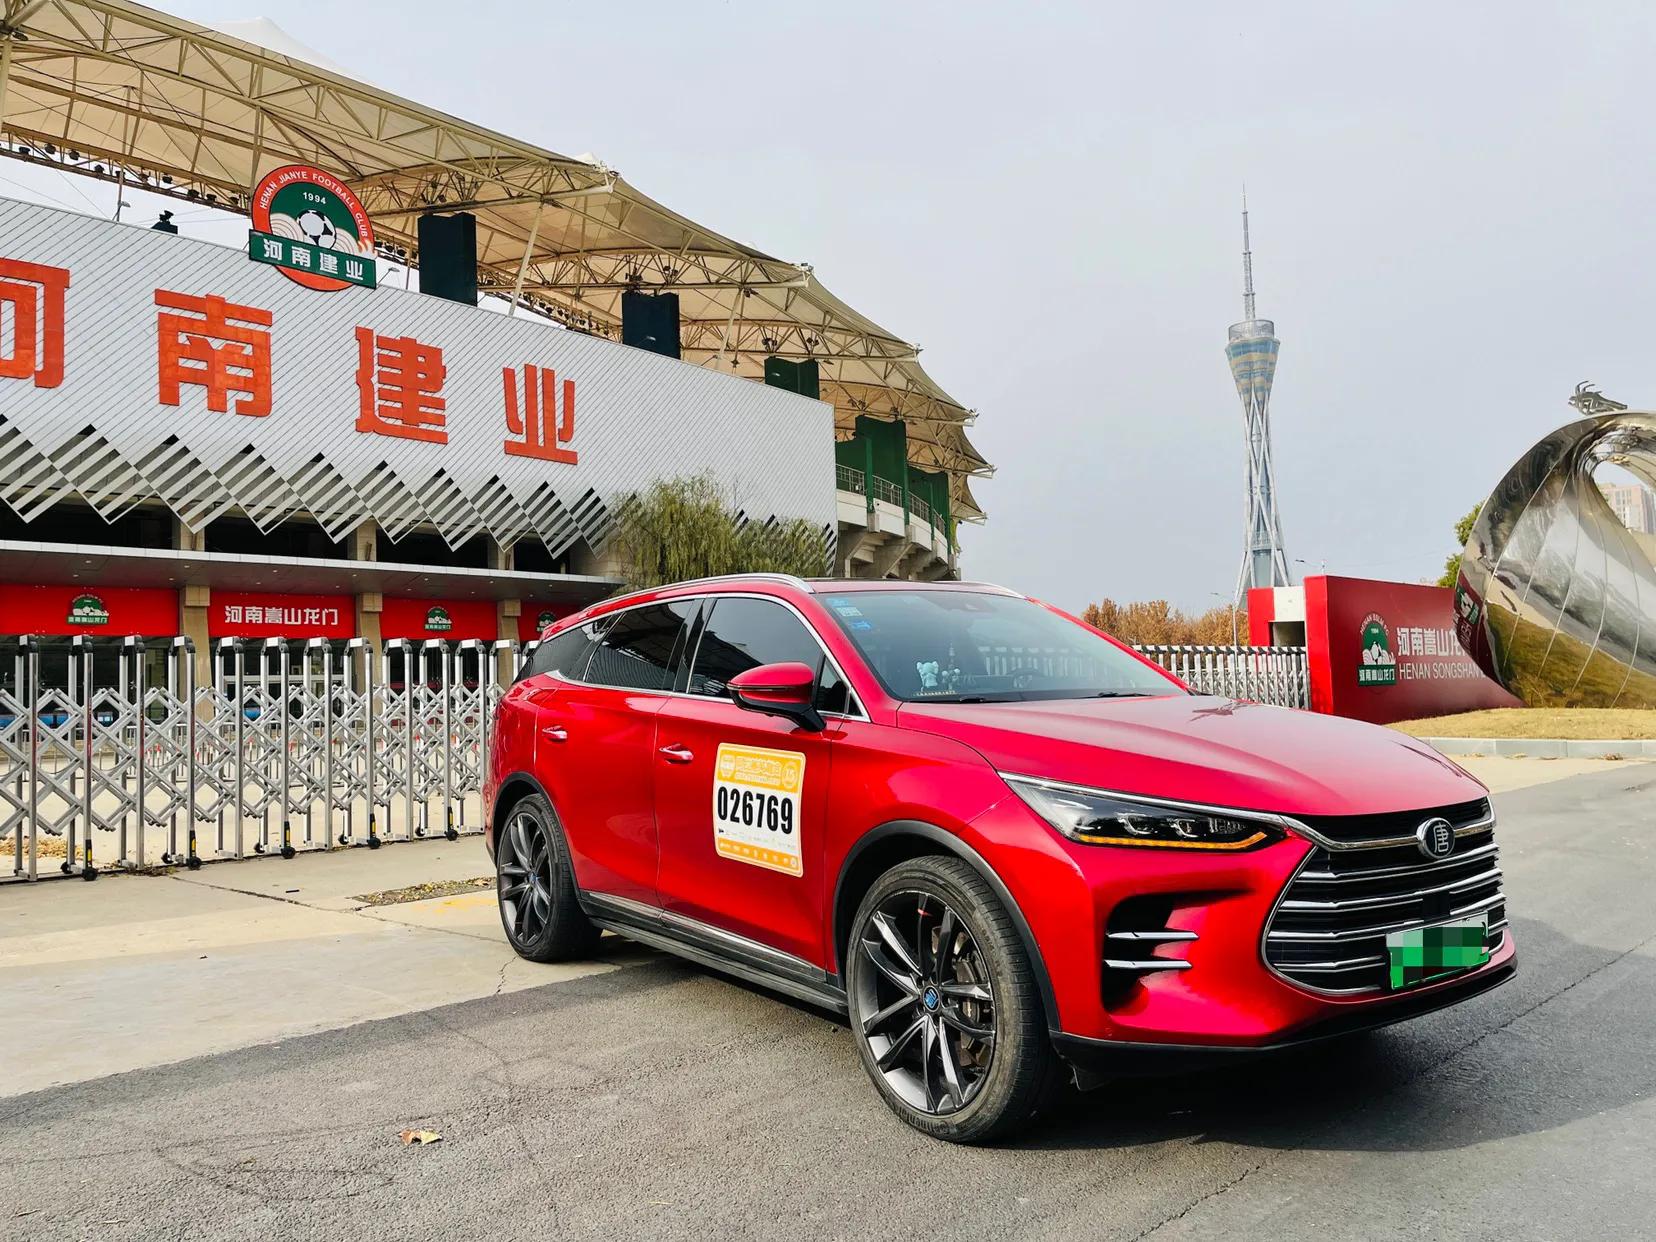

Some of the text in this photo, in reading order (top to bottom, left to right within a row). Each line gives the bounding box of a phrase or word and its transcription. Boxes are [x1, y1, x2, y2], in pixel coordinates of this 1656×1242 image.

[260, 170, 368, 237] HENAN JIANYE FOOTBALL CLUB
[303, 192, 326, 205] 1994
[263, 238, 364, 280] 河南建业
[224, 605, 338, 626] 河南嵩山龙门
[1397, 626, 1466, 656] 河南嵩山龙
[1399, 662, 1431, 680] HENAN
[717, 786, 793, 835] 026769
